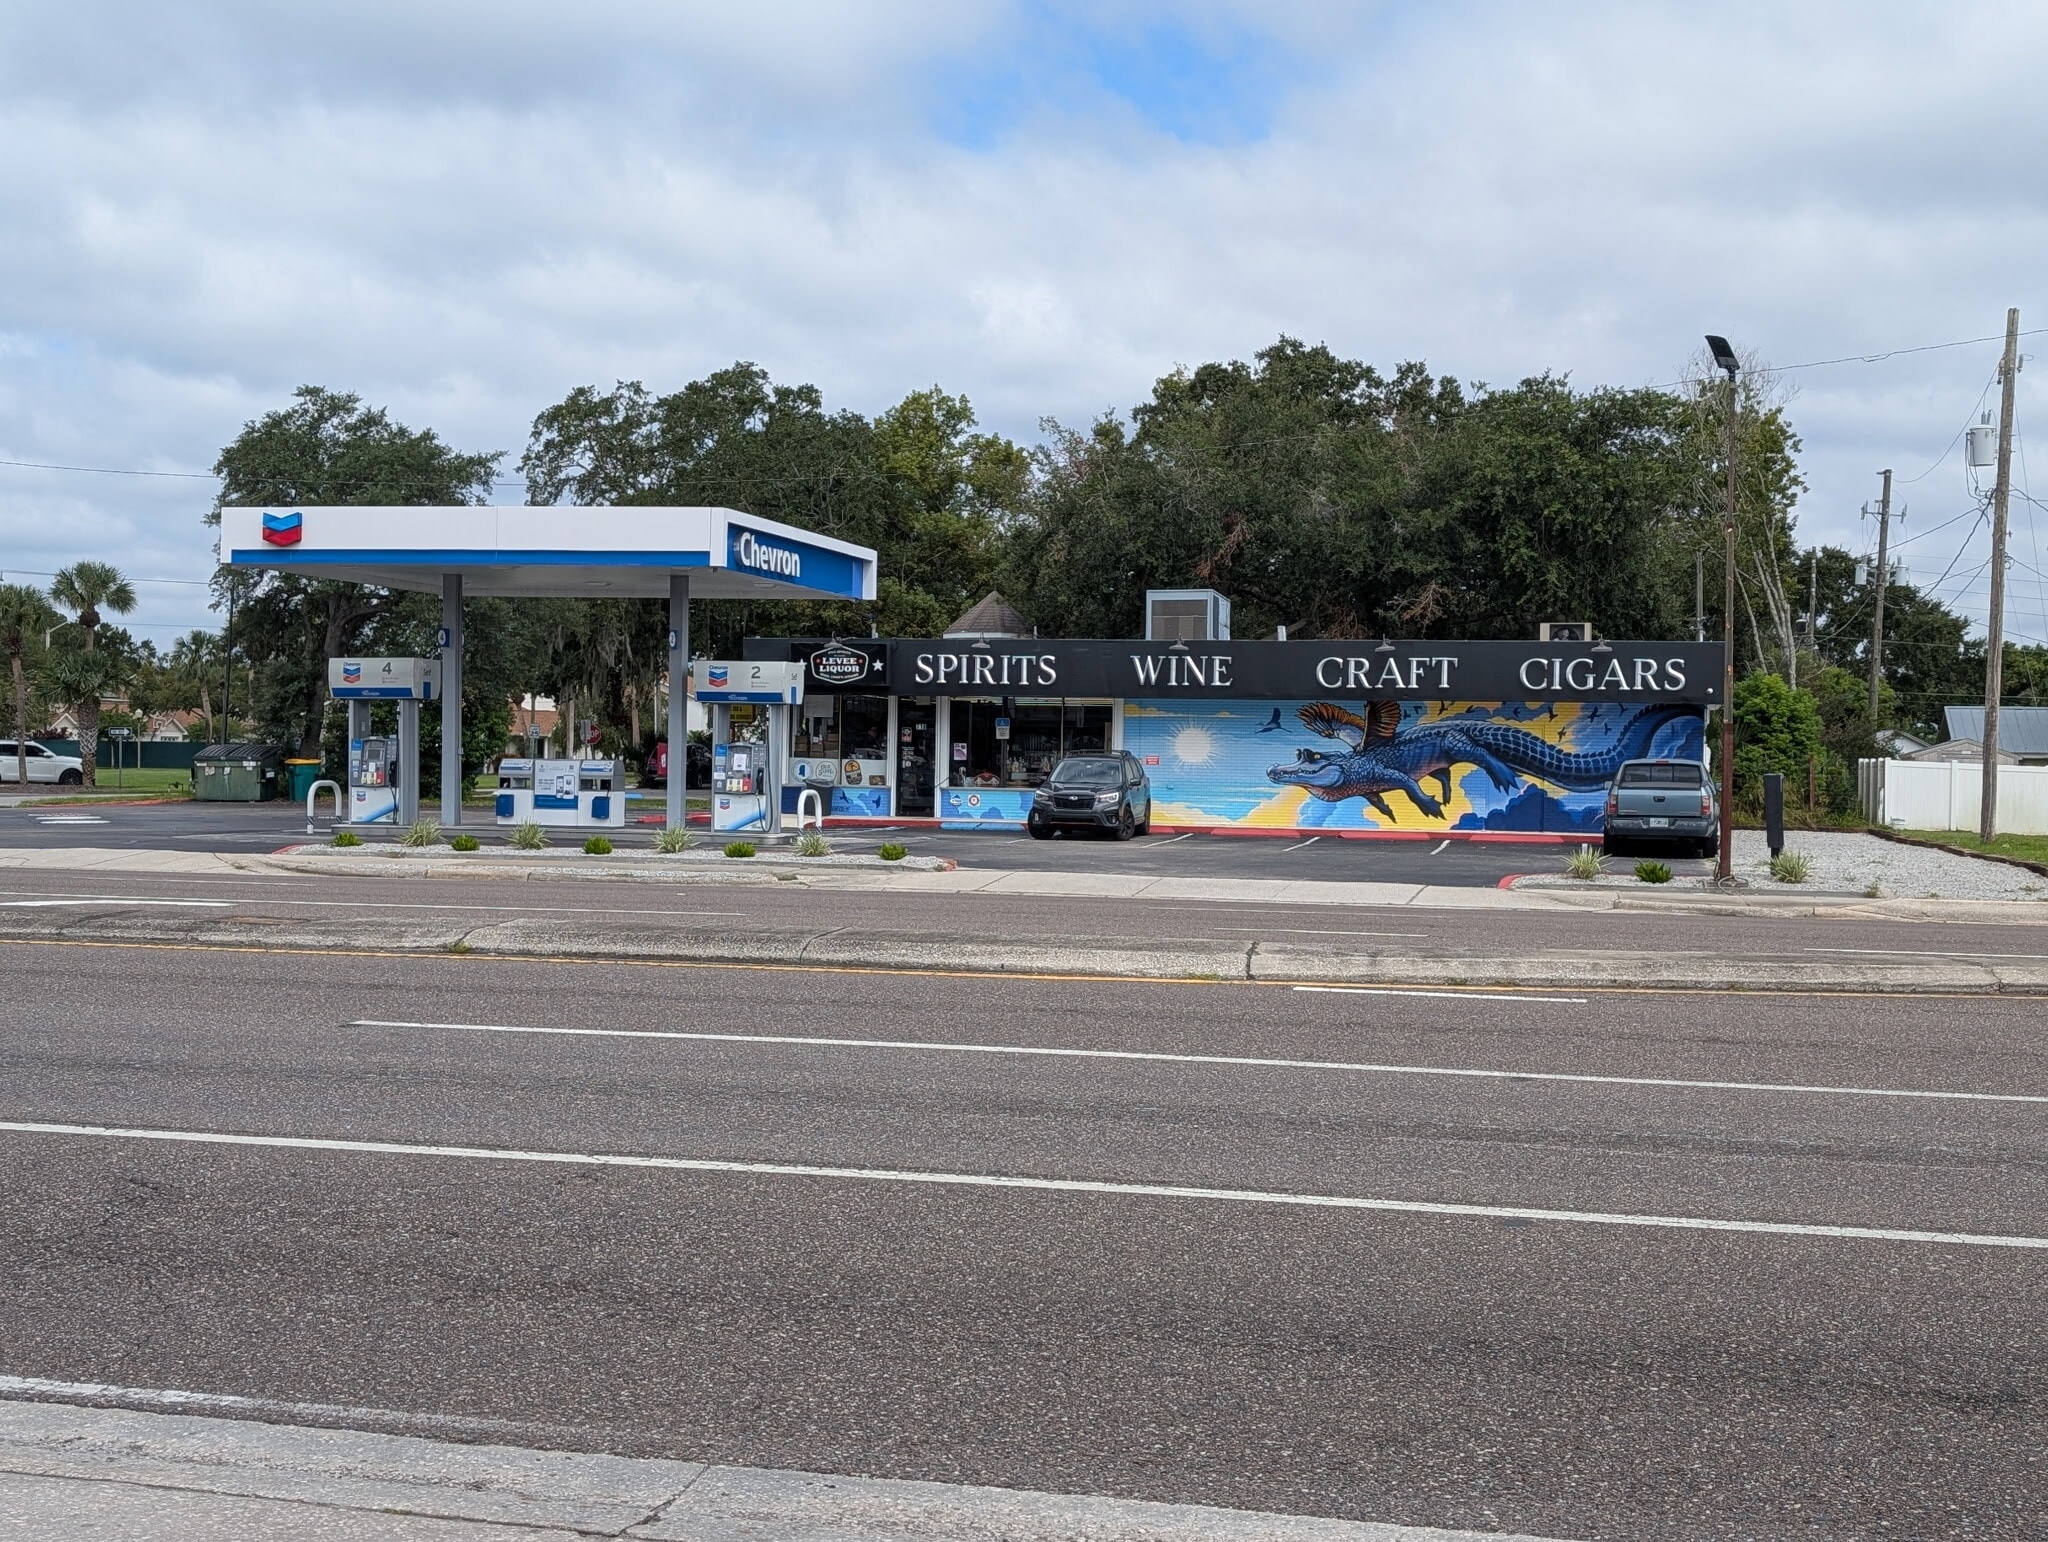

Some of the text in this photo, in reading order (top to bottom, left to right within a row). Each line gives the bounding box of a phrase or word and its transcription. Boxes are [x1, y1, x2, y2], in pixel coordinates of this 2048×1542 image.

[740, 532, 801, 578] Chevron
[822, 657, 857, 665] LEVEE
[382, 662, 392, 674] 4
[751, 666, 761, 679] 2
[819, 665, 860, 673] LIQUOR
[915, 654, 1687, 691] SPIRITS WINE CRAFT CIGARS
